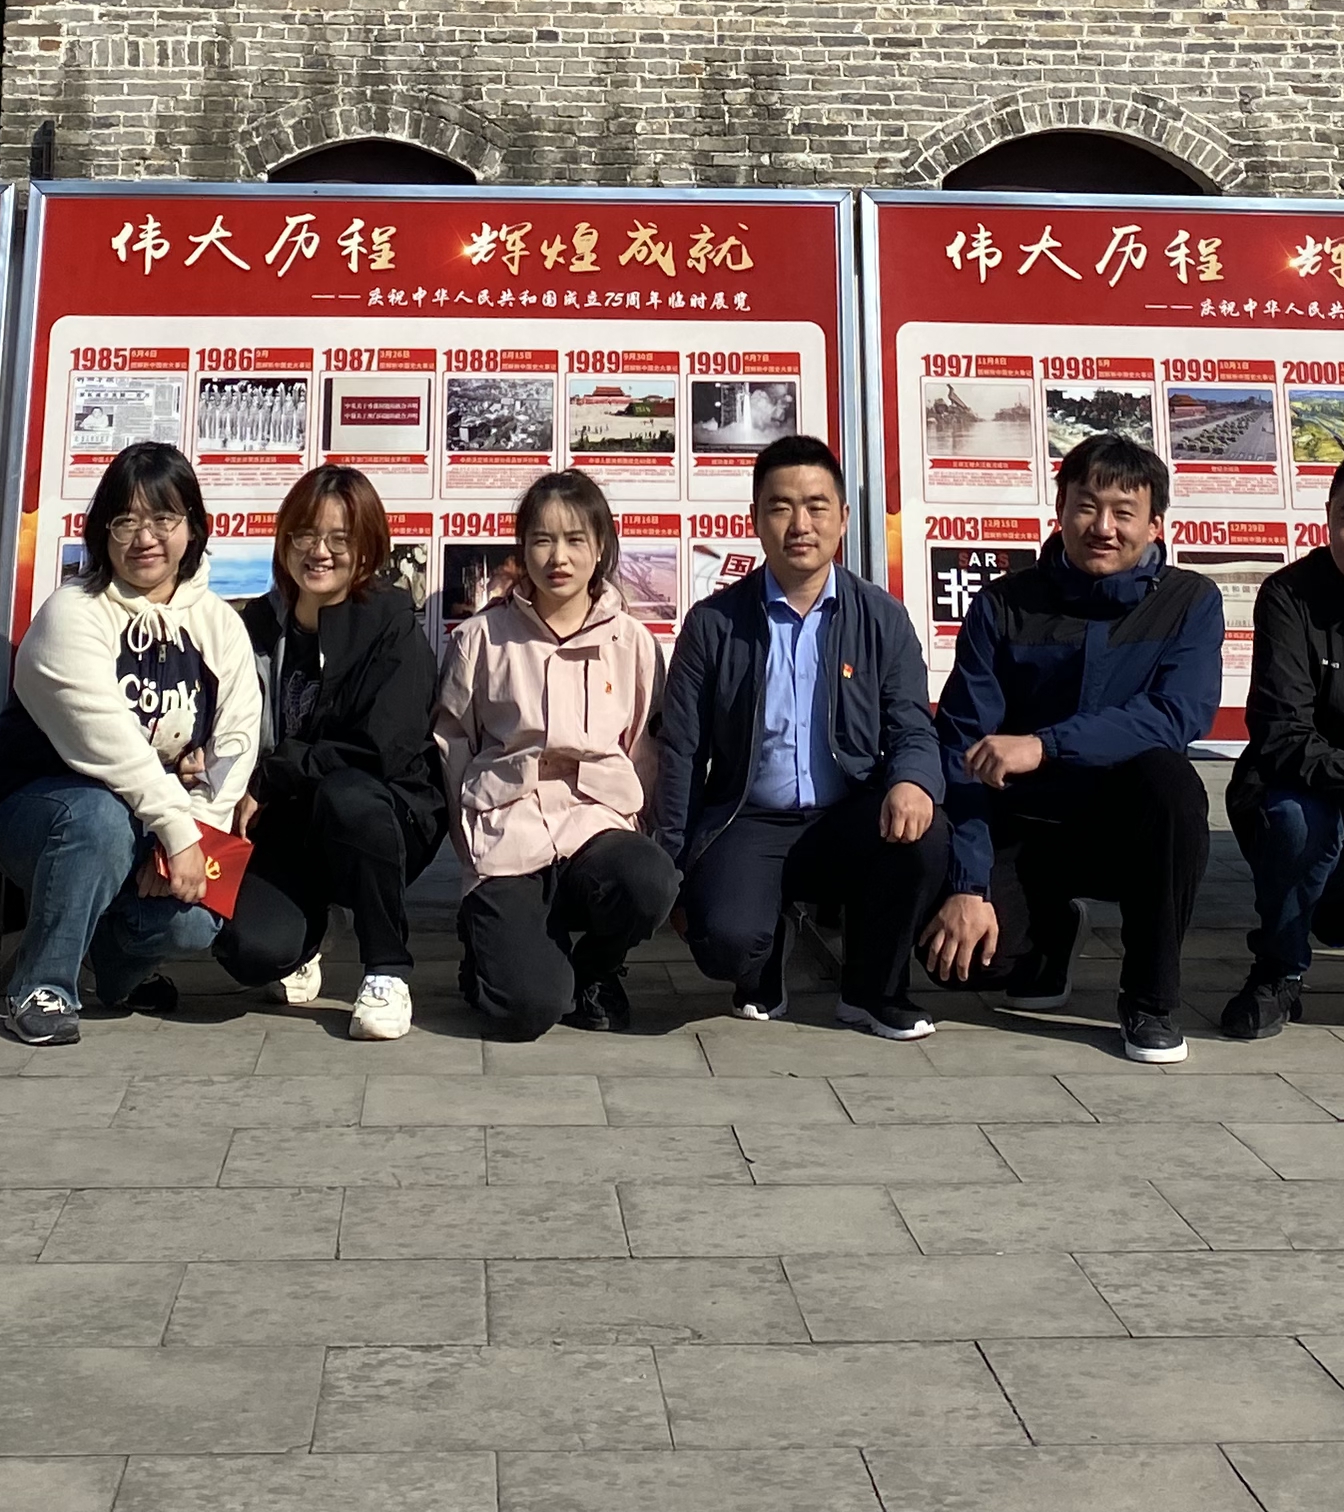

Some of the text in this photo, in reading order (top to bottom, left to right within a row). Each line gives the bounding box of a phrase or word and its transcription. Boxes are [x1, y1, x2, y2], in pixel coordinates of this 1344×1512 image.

[111, 213, 755, 278] 伟大历程 辉煌成就
[946, 222, 1224, 288] 伟大历程
[70, 347, 127, 370] 1985
[196, 348, 253, 371] 1986
[322, 348, 375, 371] 1987
[443, 349, 499, 372] 1988
[565, 350, 621, 373] 1989
[686, 352, 741, 375] 1990
[921, 354, 973, 377] 1997
[1039, 357, 1095, 380] 1998
[1160, 359, 1217, 382] 1999
[1283, 361, 1337, 384] 2000
[207, 513, 246, 537] 92
[439, 512, 497, 537] 1994
[687, 514, 746, 538] 1996
[925, 516, 979, 540] 2003
[1171, 521, 1227, 545] 2005
[1294, 522, 1331, 546] 200
[719, 553, 757, 578] 国
[958, 551, 1010, 568] SARS
